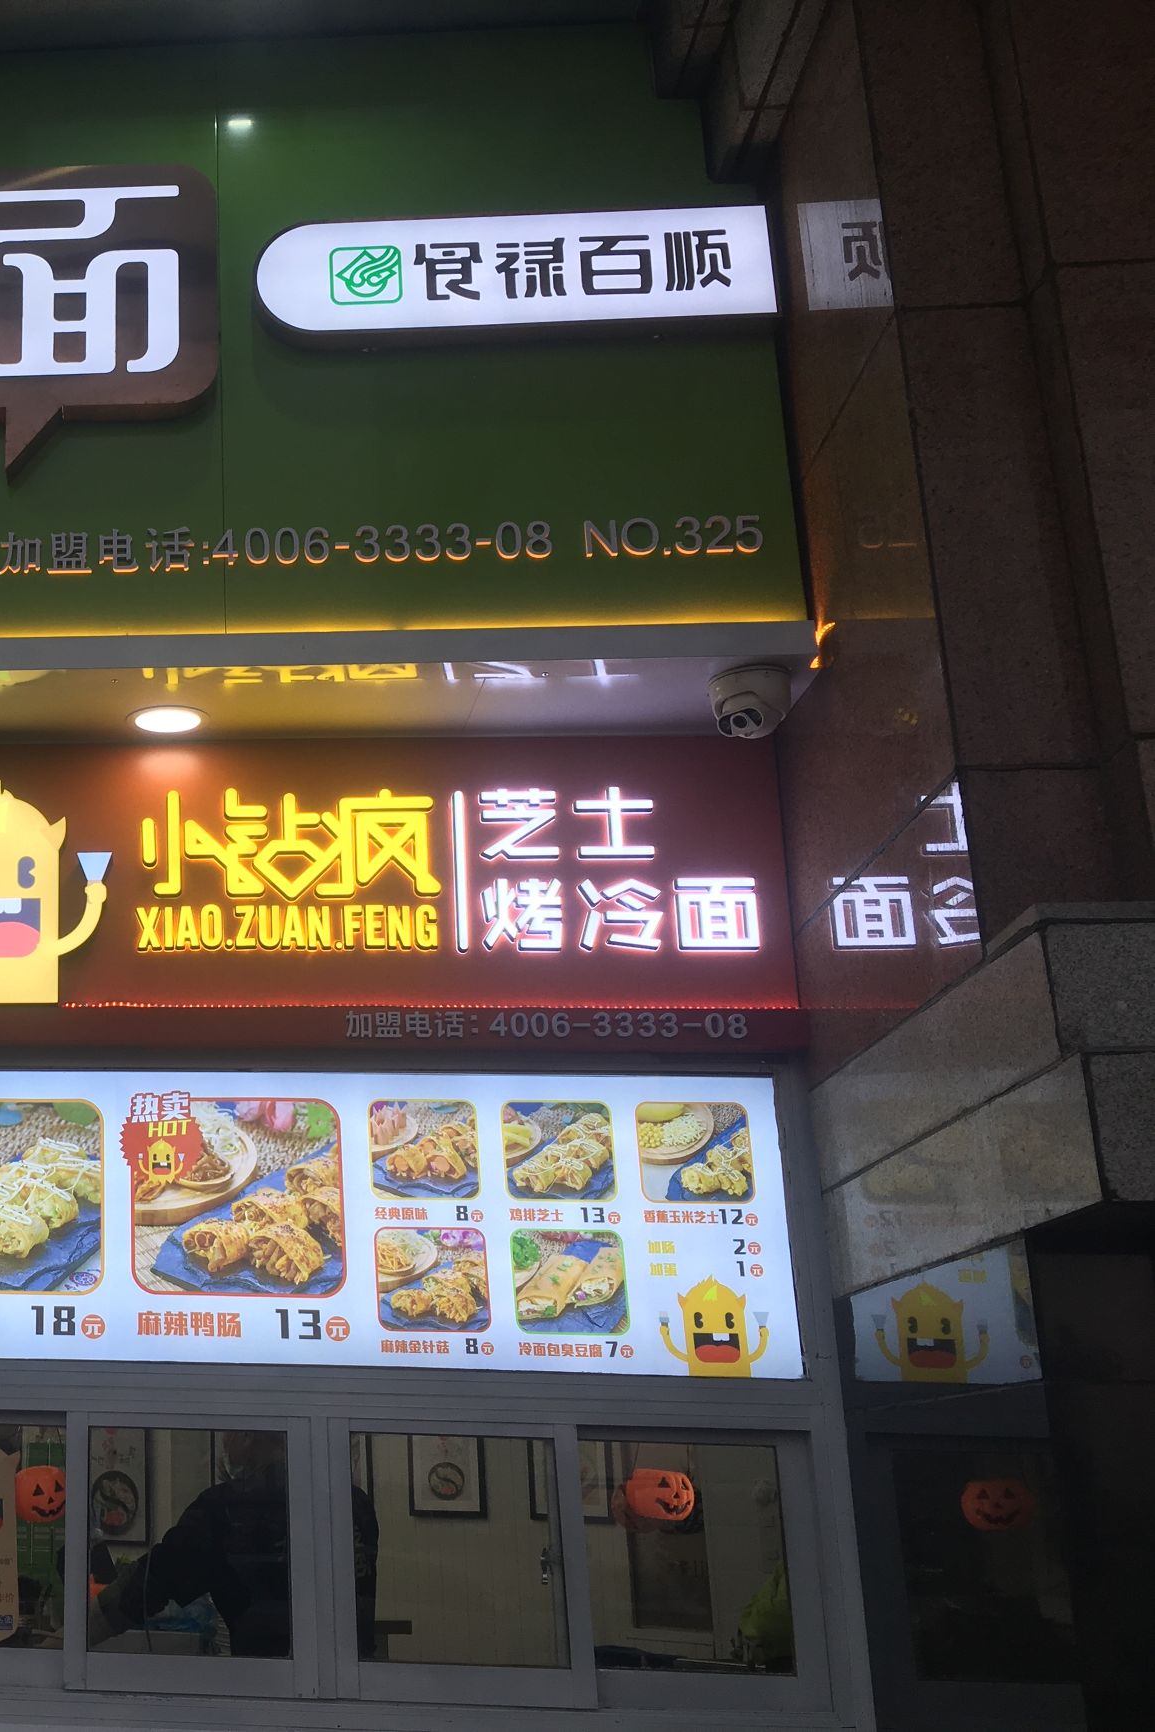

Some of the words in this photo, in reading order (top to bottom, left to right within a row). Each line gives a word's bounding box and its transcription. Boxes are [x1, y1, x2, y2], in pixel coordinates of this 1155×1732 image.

[414, 229, 732, 300] 食禄百顺
[584, 514, 765, 558] NO.325
[479, 787, 655, 861] 芝士
[480, 876, 761, 952] 烤冷面
[131, 1091, 191, 1122] 热卖
[148, 1119, 191, 1138] HOT
[374, 1206, 428, 1221] 经典原味
[509, 1208, 564, 1222] 鸡排芝士
[643, 1209, 719, 1224] 香蕉玉米芝士
[137, 1310, 243, 1338] 麻辣鸭肠
[380, 1339, 450, 1354] 麻辣金针菇
[518, 1341, 603, 1358] 冷面包臭豆腐
